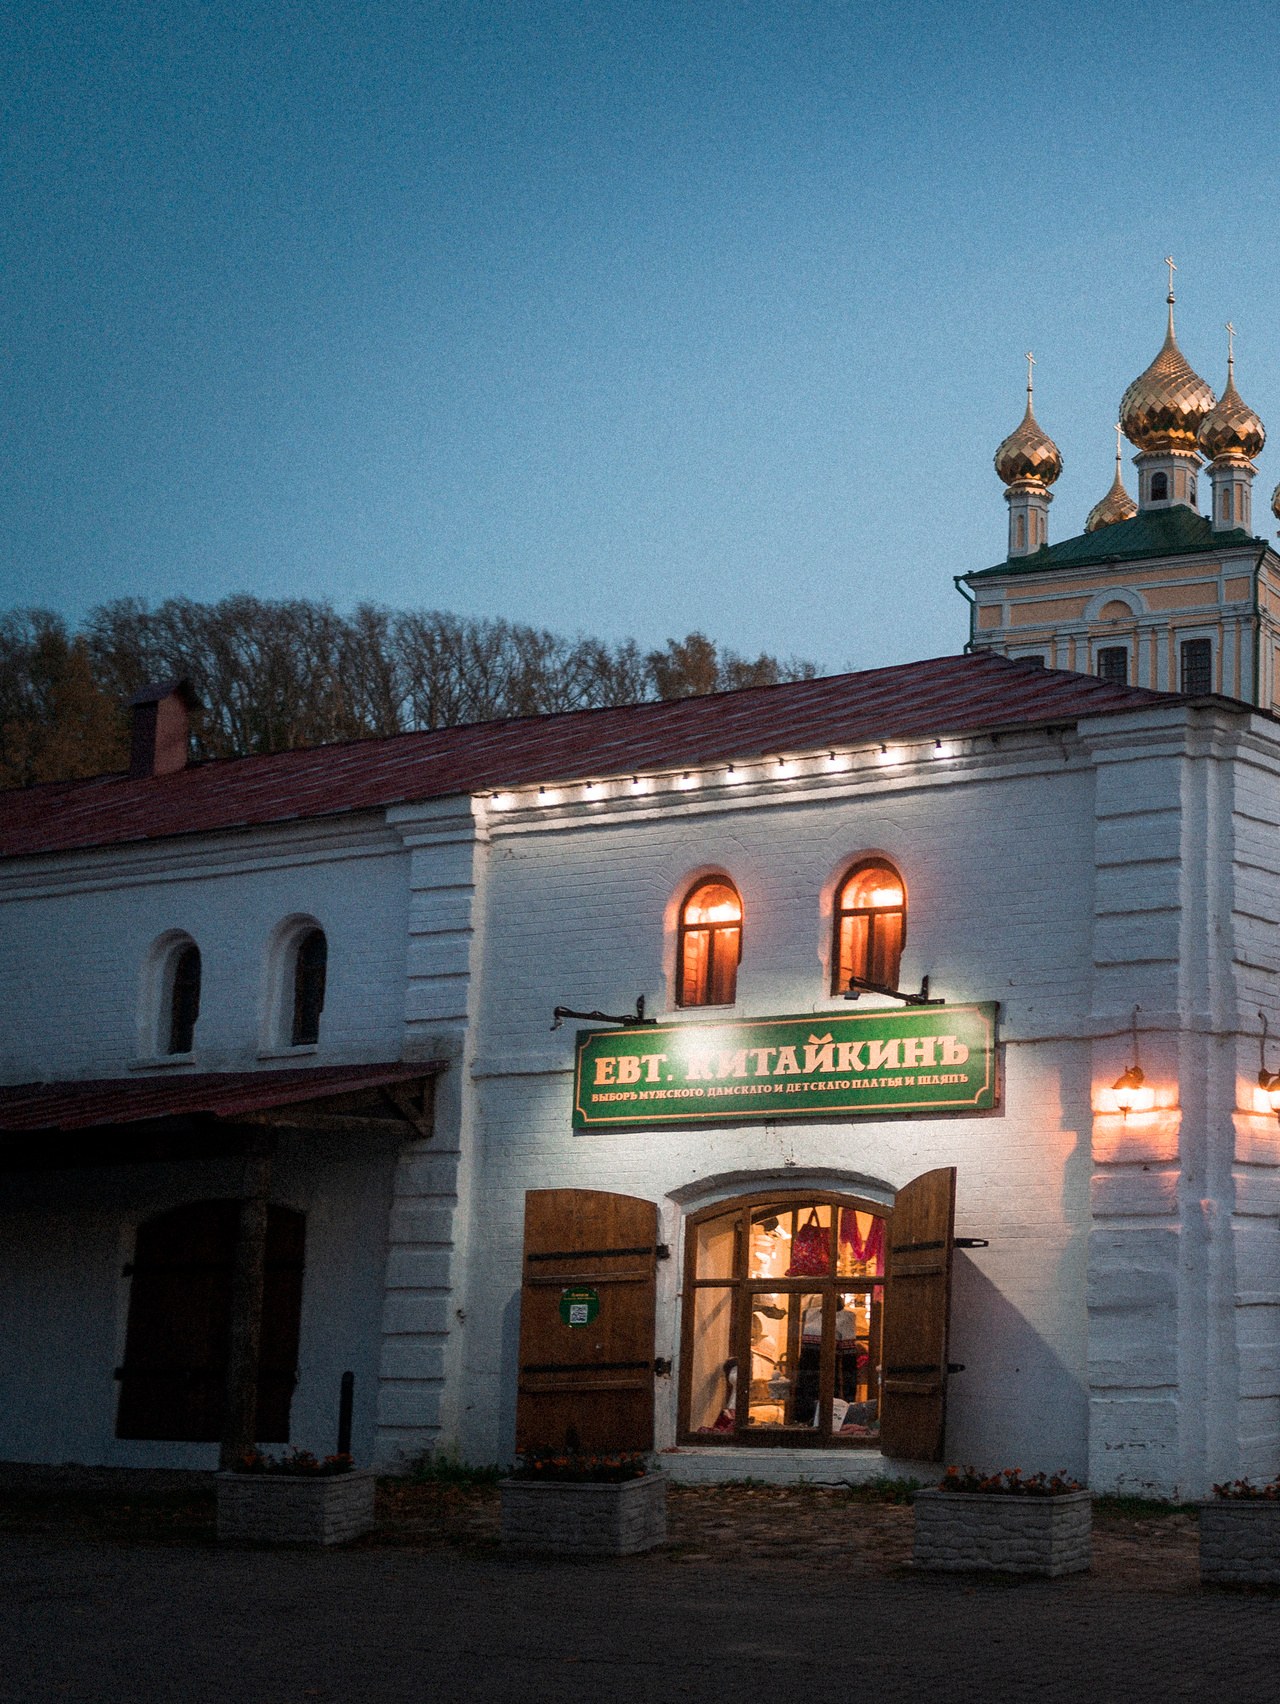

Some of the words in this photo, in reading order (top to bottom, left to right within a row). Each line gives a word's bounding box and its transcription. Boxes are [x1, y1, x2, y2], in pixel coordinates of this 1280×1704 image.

[593, 1054, 674, 1086] ЕВТ.
[684, 1032, 970, 1082] КИТАЙКИНЪ
[591, 1092, 638, 1103] ВЫБОРЪ
[773, 1083, 784, 1094] И
[785, 1079, 851, 1094] ДЕТСКАГО
[851, 1076, 904, 1089] ПЛАТЬЯ
[904, 1075, 916, 1087] И
[917, 1073, 969, 1086] ШЛЯПЪ
